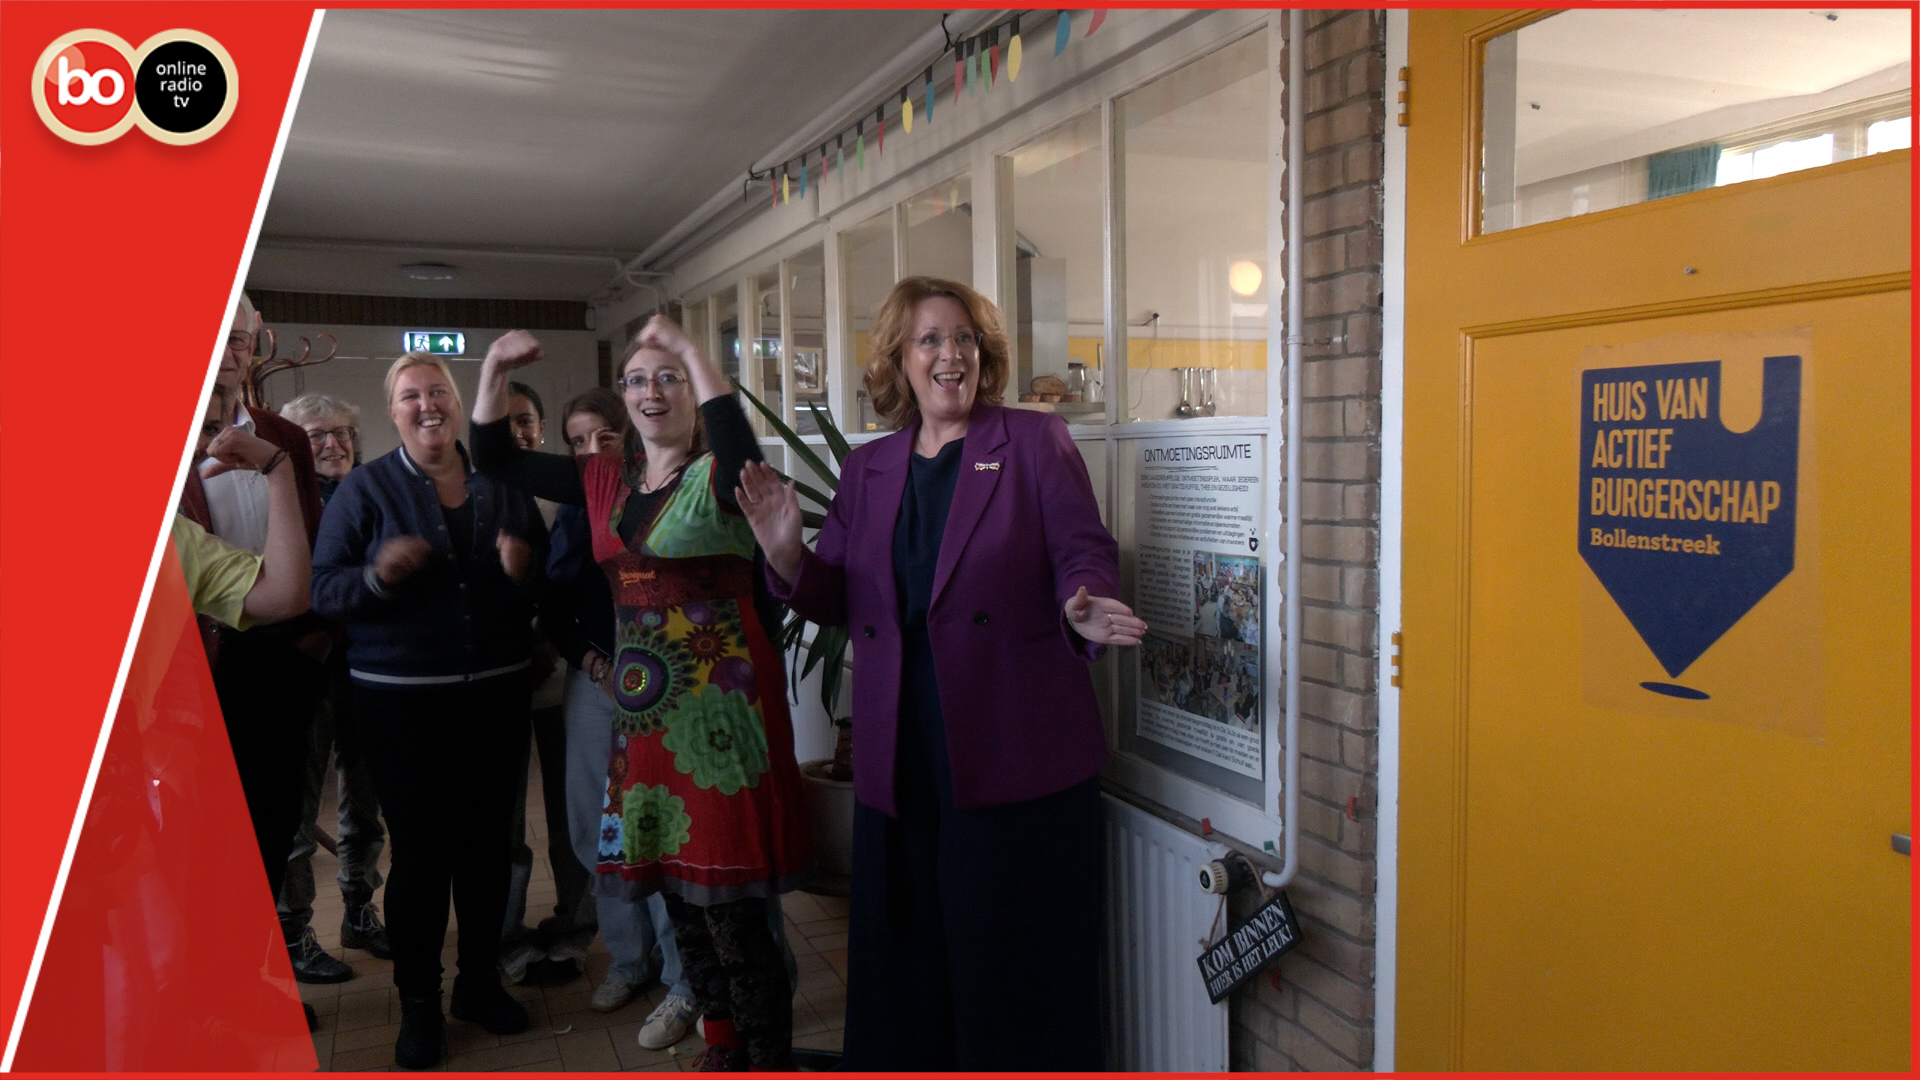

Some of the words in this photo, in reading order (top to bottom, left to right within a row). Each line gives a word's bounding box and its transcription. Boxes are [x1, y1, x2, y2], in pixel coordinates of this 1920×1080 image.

[1593, 381, 1647, 422] HUIS
[1655, 377, 1709, 420] VAN
[1144, 444, 1252, 462] ONTMOETINGSRUIMTE
[1591, 428, 1674, 469] ACTIEF
[1590, 477, 1782, 524] BURGERSCHAP
[1590, 528, 1721, 555] Bollenstreek
[1202, 940, 1236, 979] KOM
[1232, 899, 1286, 955] BINNEN
[1210, 970, 1234, 996] HIER
[1231, 962, 1243, 980] IS
[1241, 946, 1262, 973] HET
[1261, 924, 1293, 958] LEUK!
